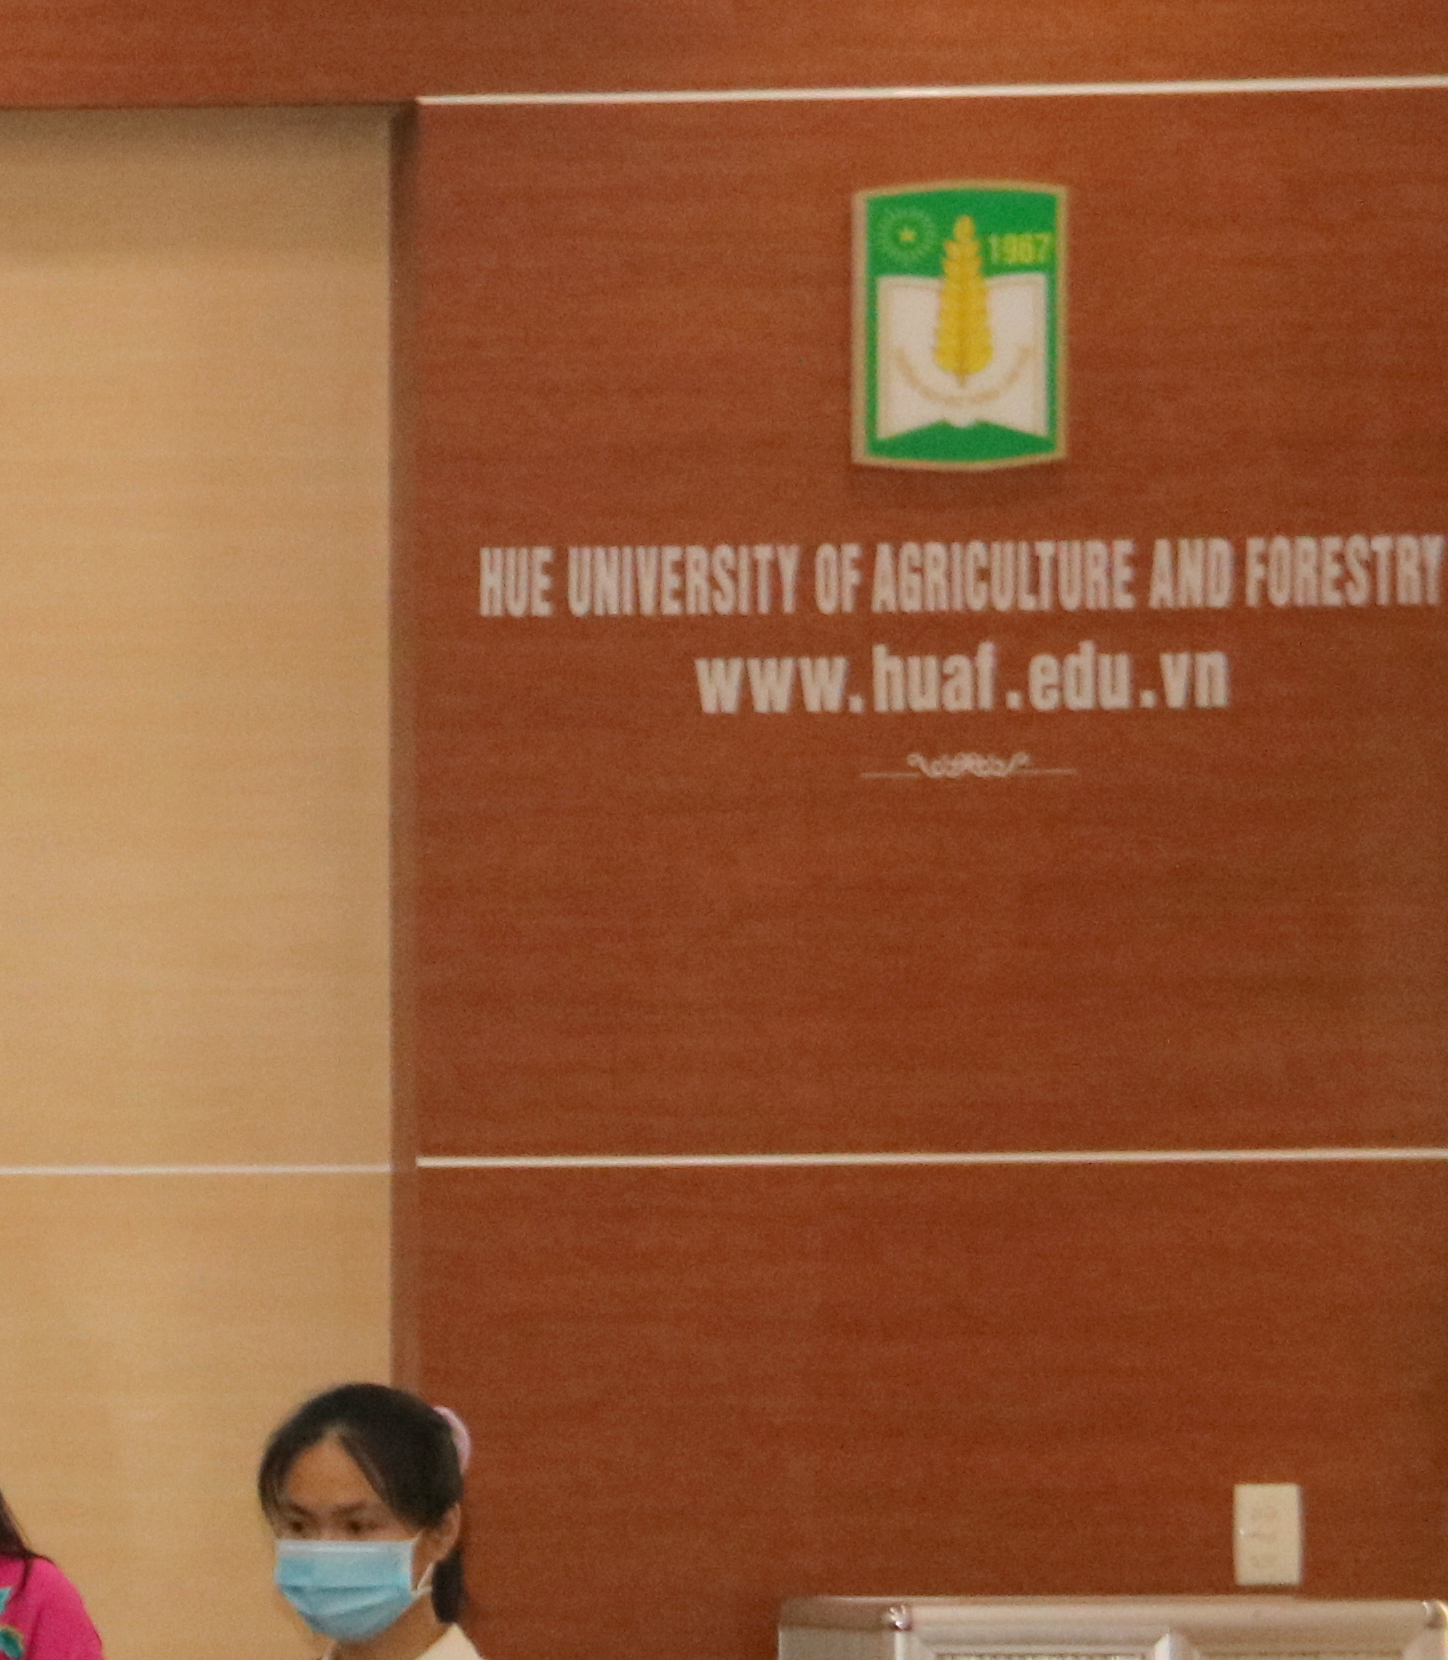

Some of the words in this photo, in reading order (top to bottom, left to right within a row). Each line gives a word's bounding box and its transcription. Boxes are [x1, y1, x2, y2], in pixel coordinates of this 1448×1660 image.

[989, 232, 1052, 267] 1967
[479, 546, 553, 617] HUE
[567, 543, 801, 616] UNIVERSITY
[814, 542, 863, 614] OF
[871, 538, 1136, 612] AGRICULTURE
[1148, 536, 1234, 610] AND
[1245, 533, 1445, 608] FORESTRY
[695, 640, 1231, 714] www.huaf.edu.vn
